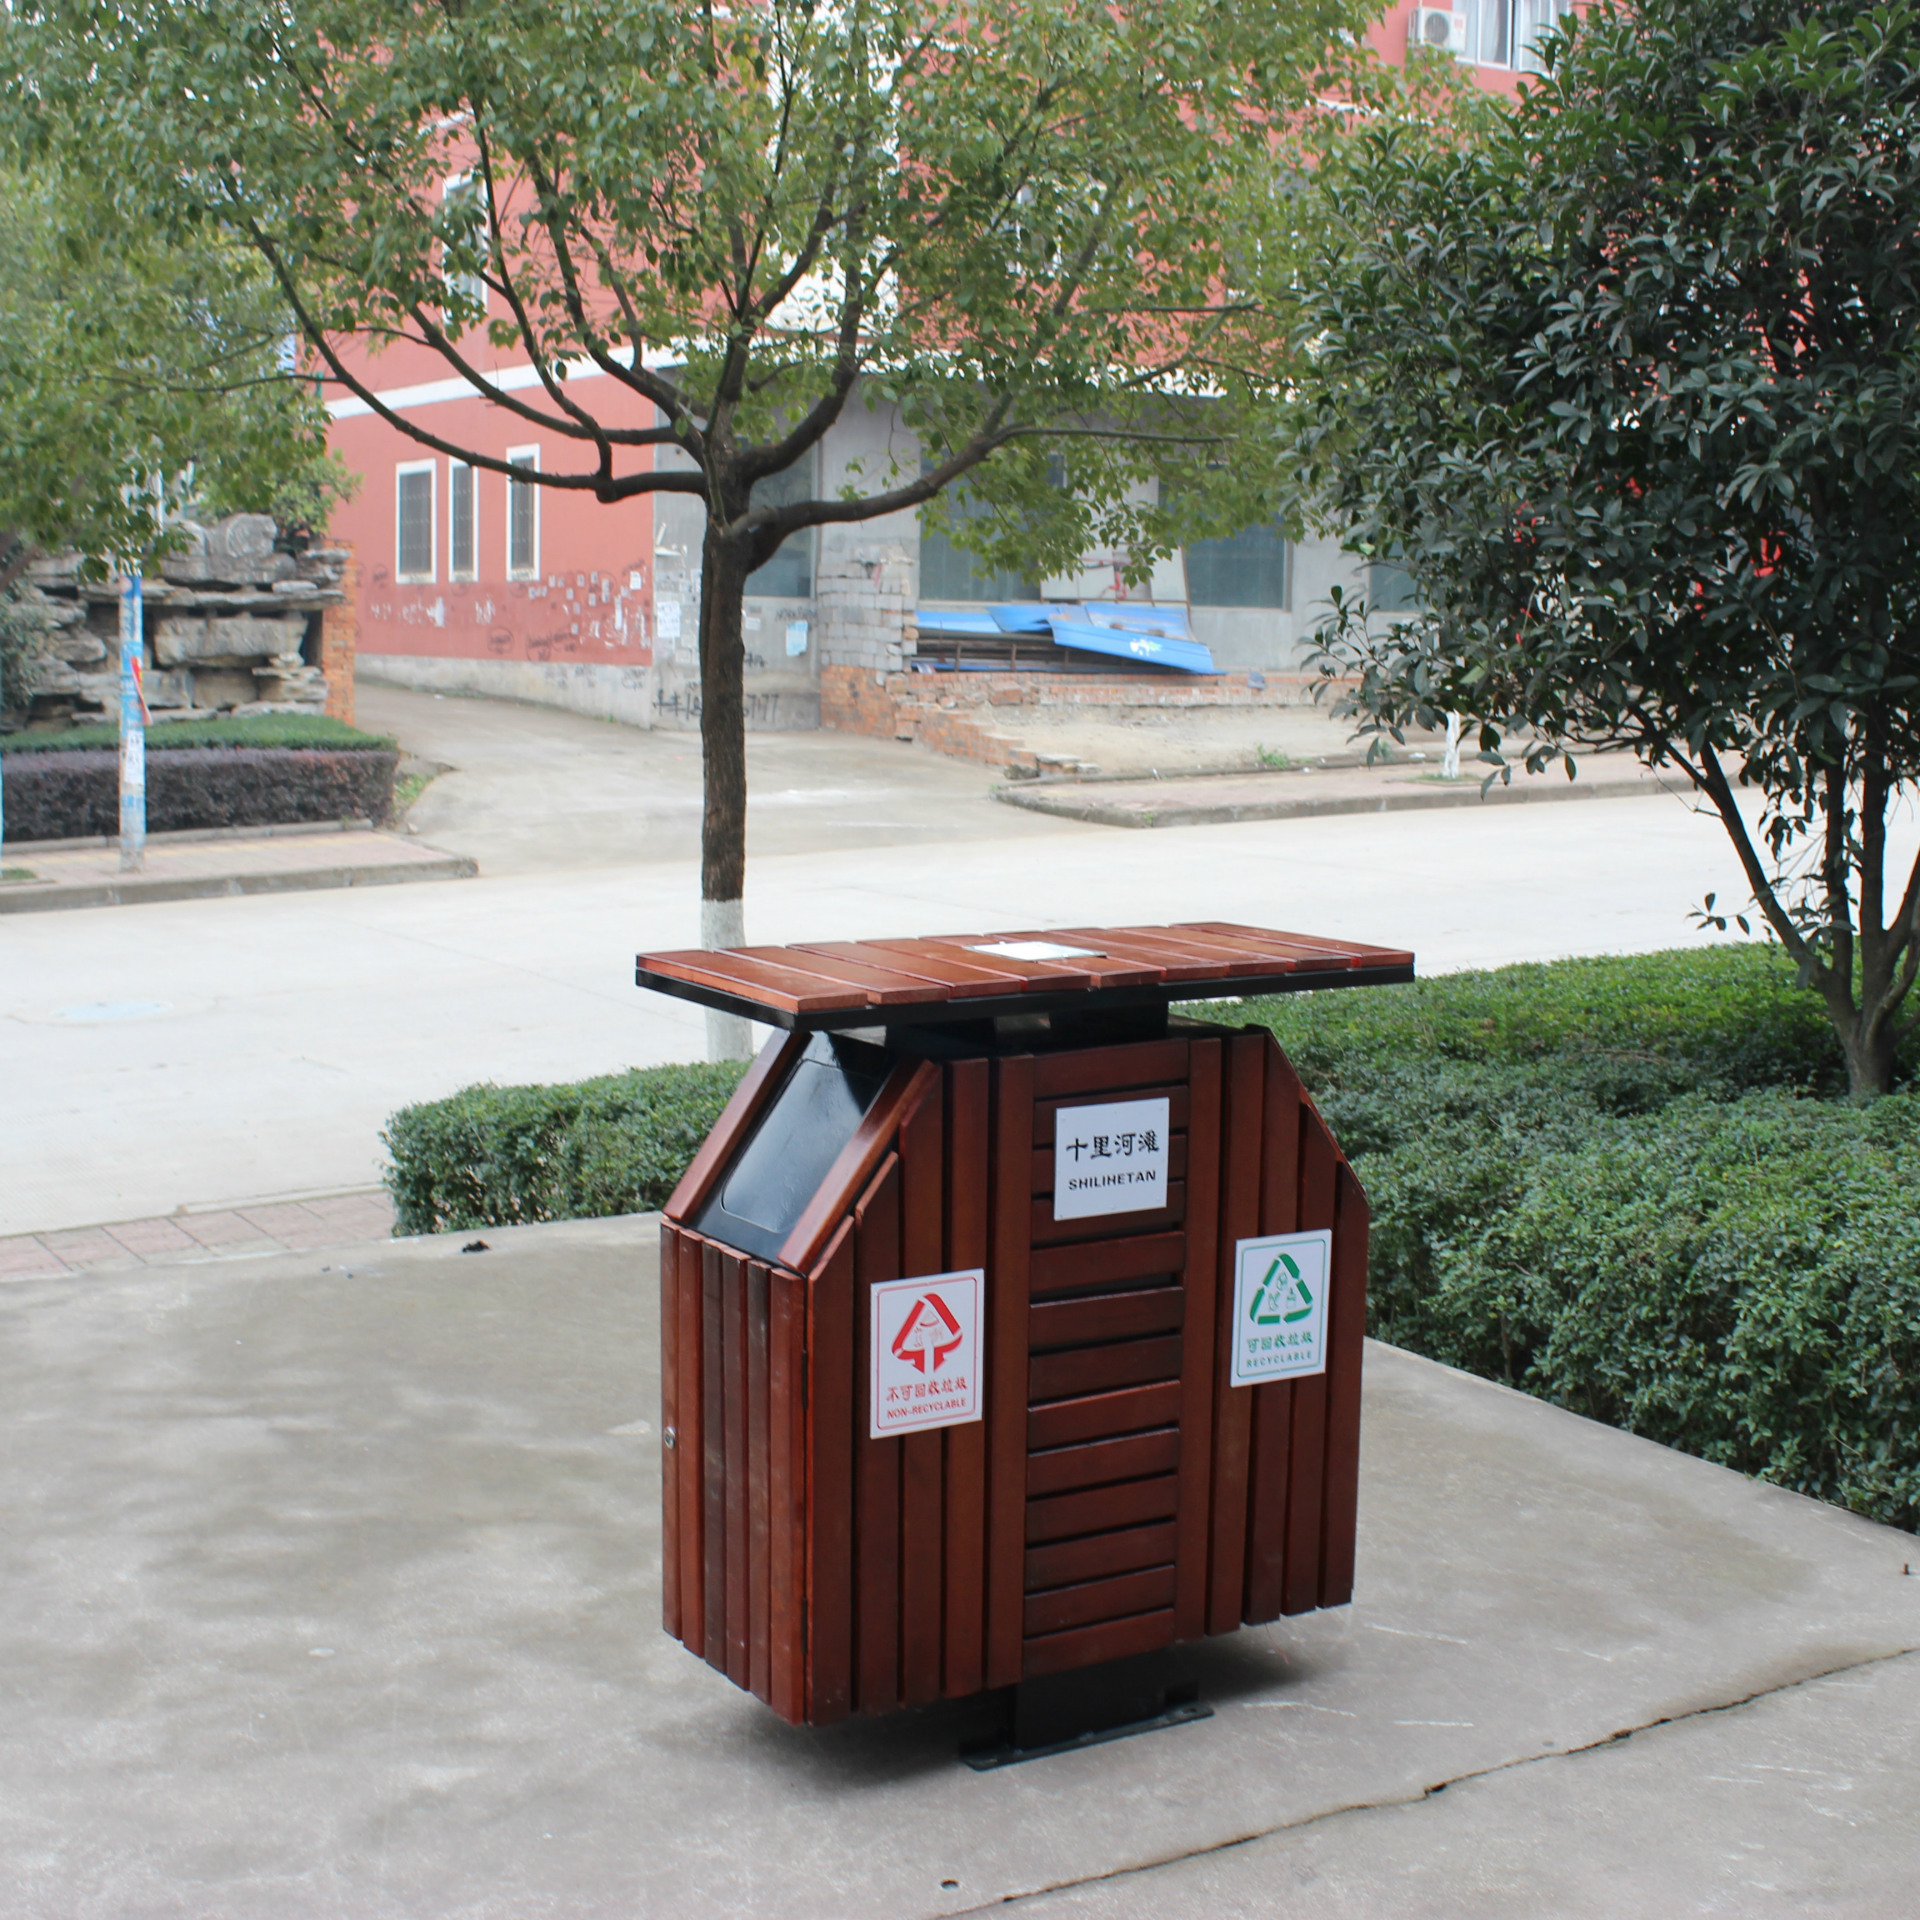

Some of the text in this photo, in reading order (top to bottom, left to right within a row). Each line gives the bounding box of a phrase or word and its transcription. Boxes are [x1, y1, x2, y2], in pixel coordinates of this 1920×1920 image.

[1068, 1170, 1156, 1191] SHILIHETAN
[1246, 1331, 1314, 1353] 可回收垃圾
[1246, 1350, 1312, 1368] RECYCLABLE
[886, 1376, 968, 1402] 不可回收垃圾
[887, 1398, 967, 1419] NON-RECYCLABLE
